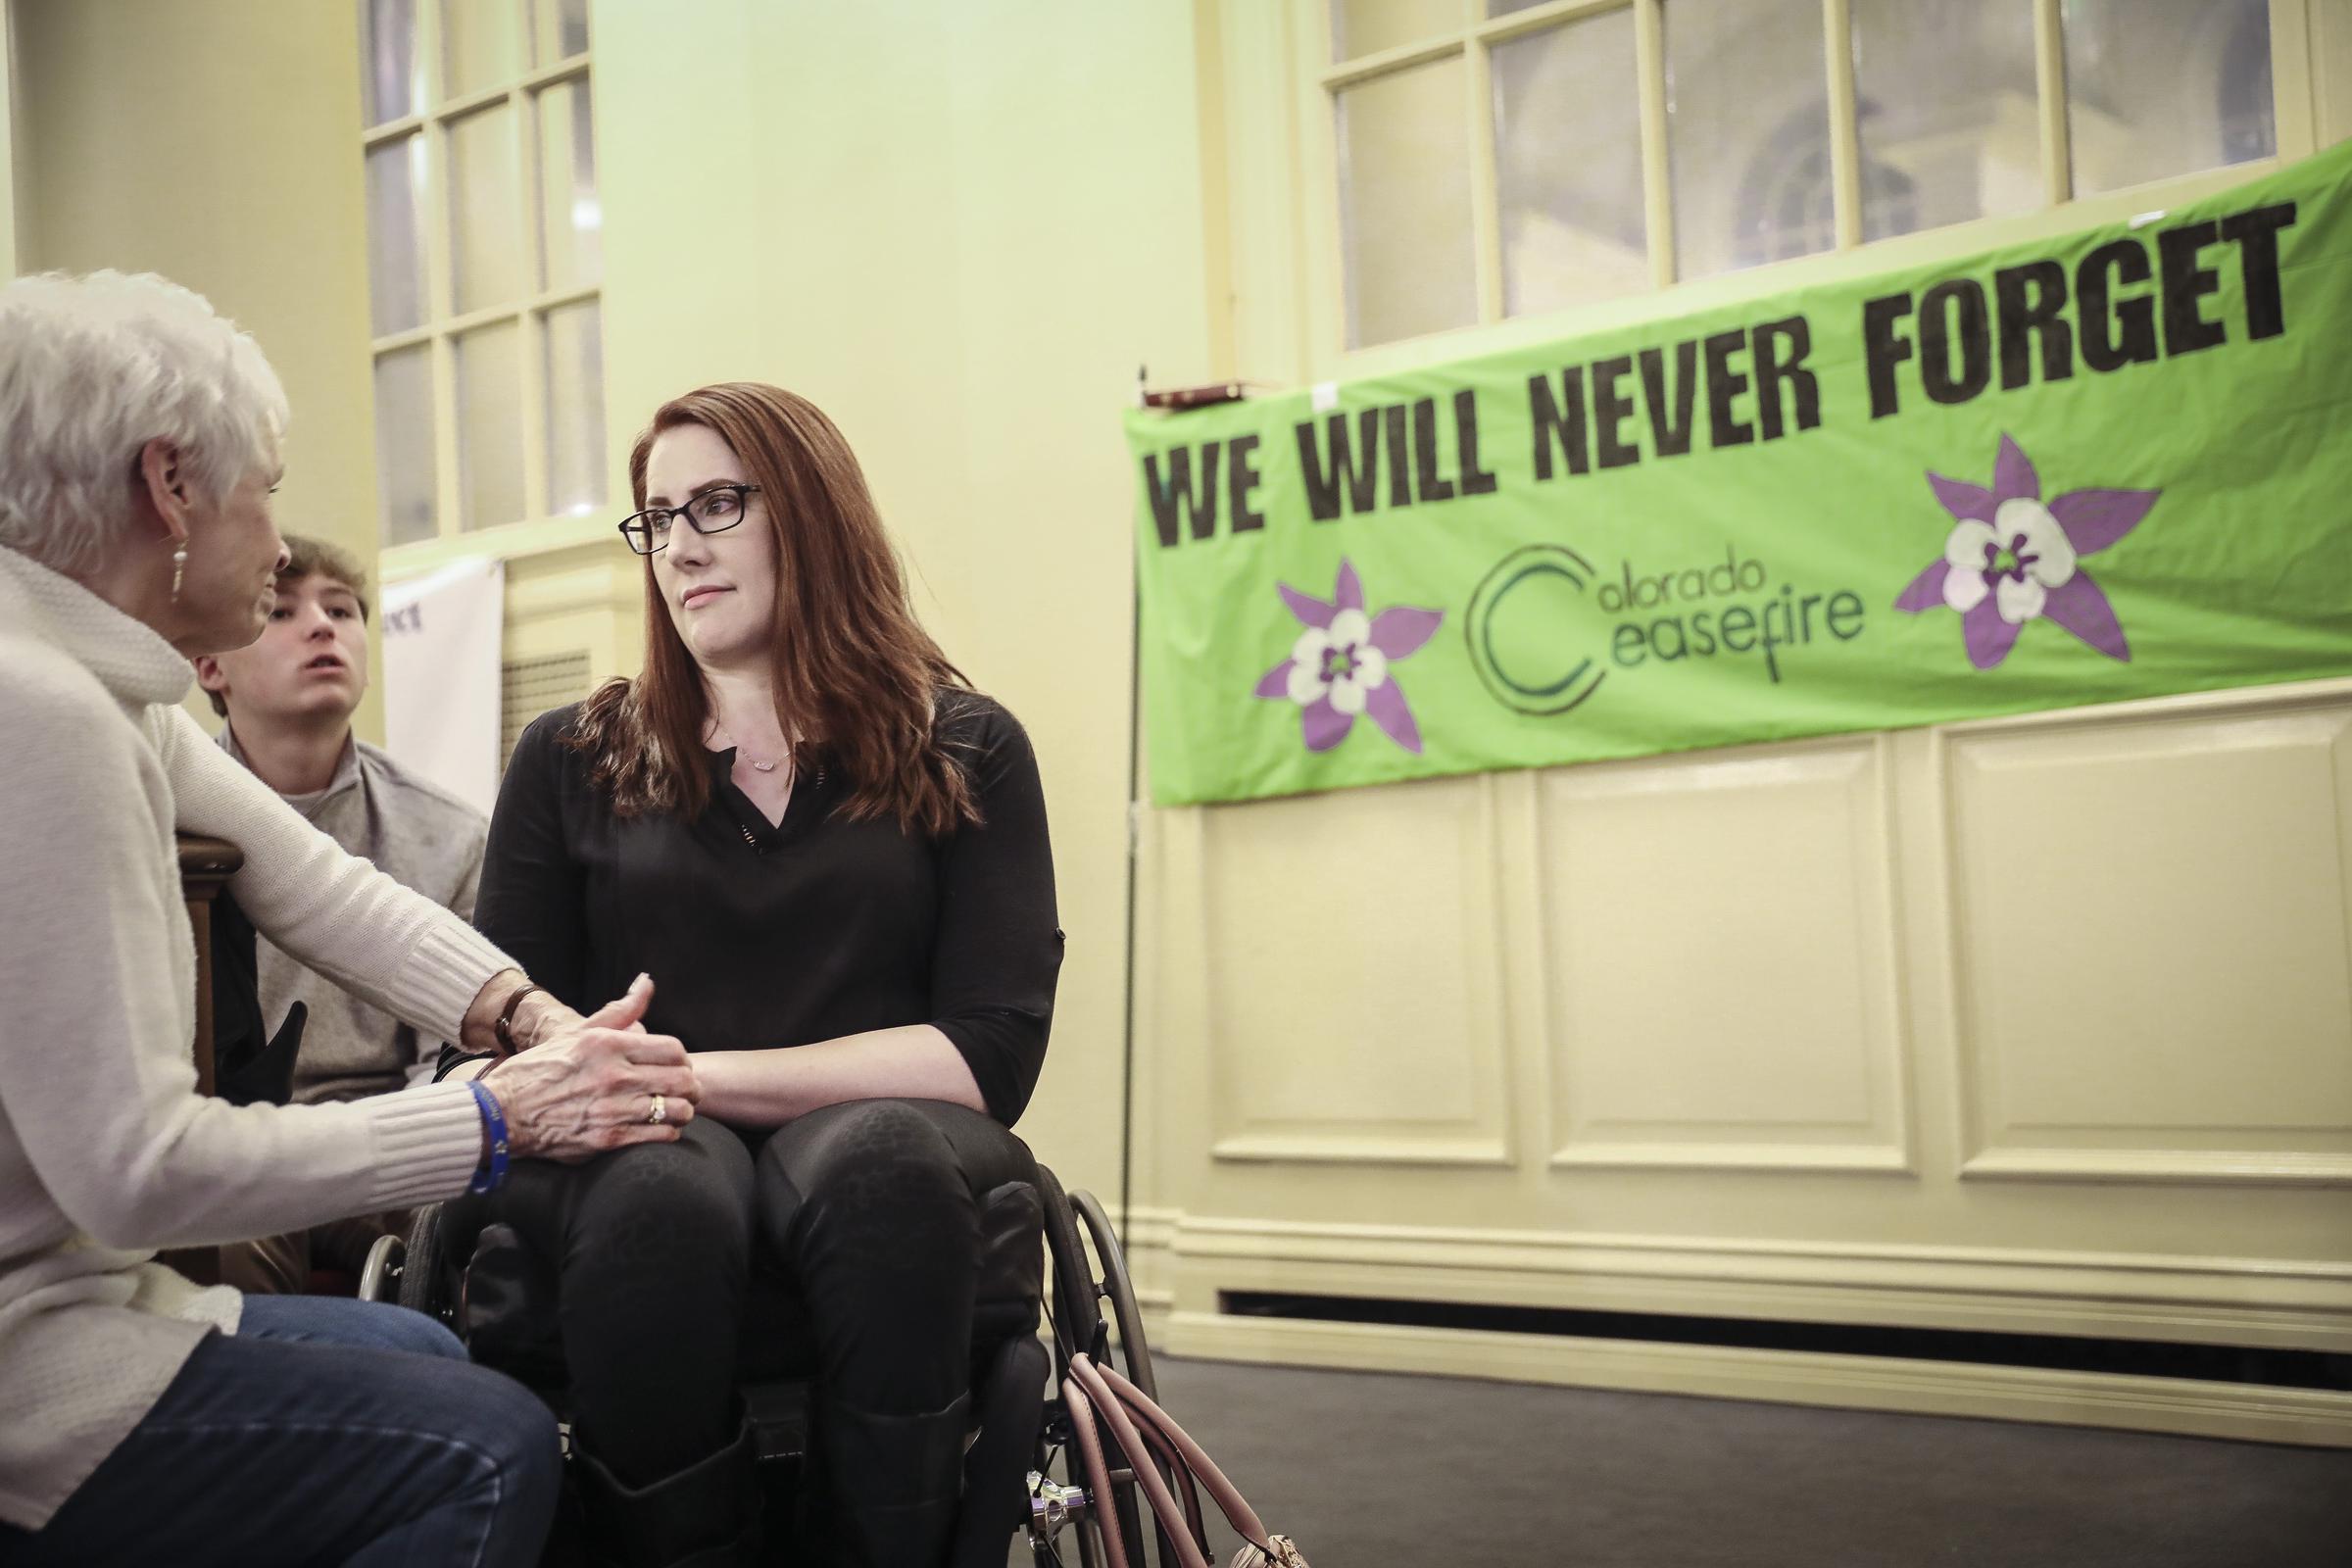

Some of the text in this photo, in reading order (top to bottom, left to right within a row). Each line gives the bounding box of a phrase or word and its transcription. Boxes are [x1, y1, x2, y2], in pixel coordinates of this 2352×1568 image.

[1144, 201, 2297, 549] WE WILL NEVER FORGET
